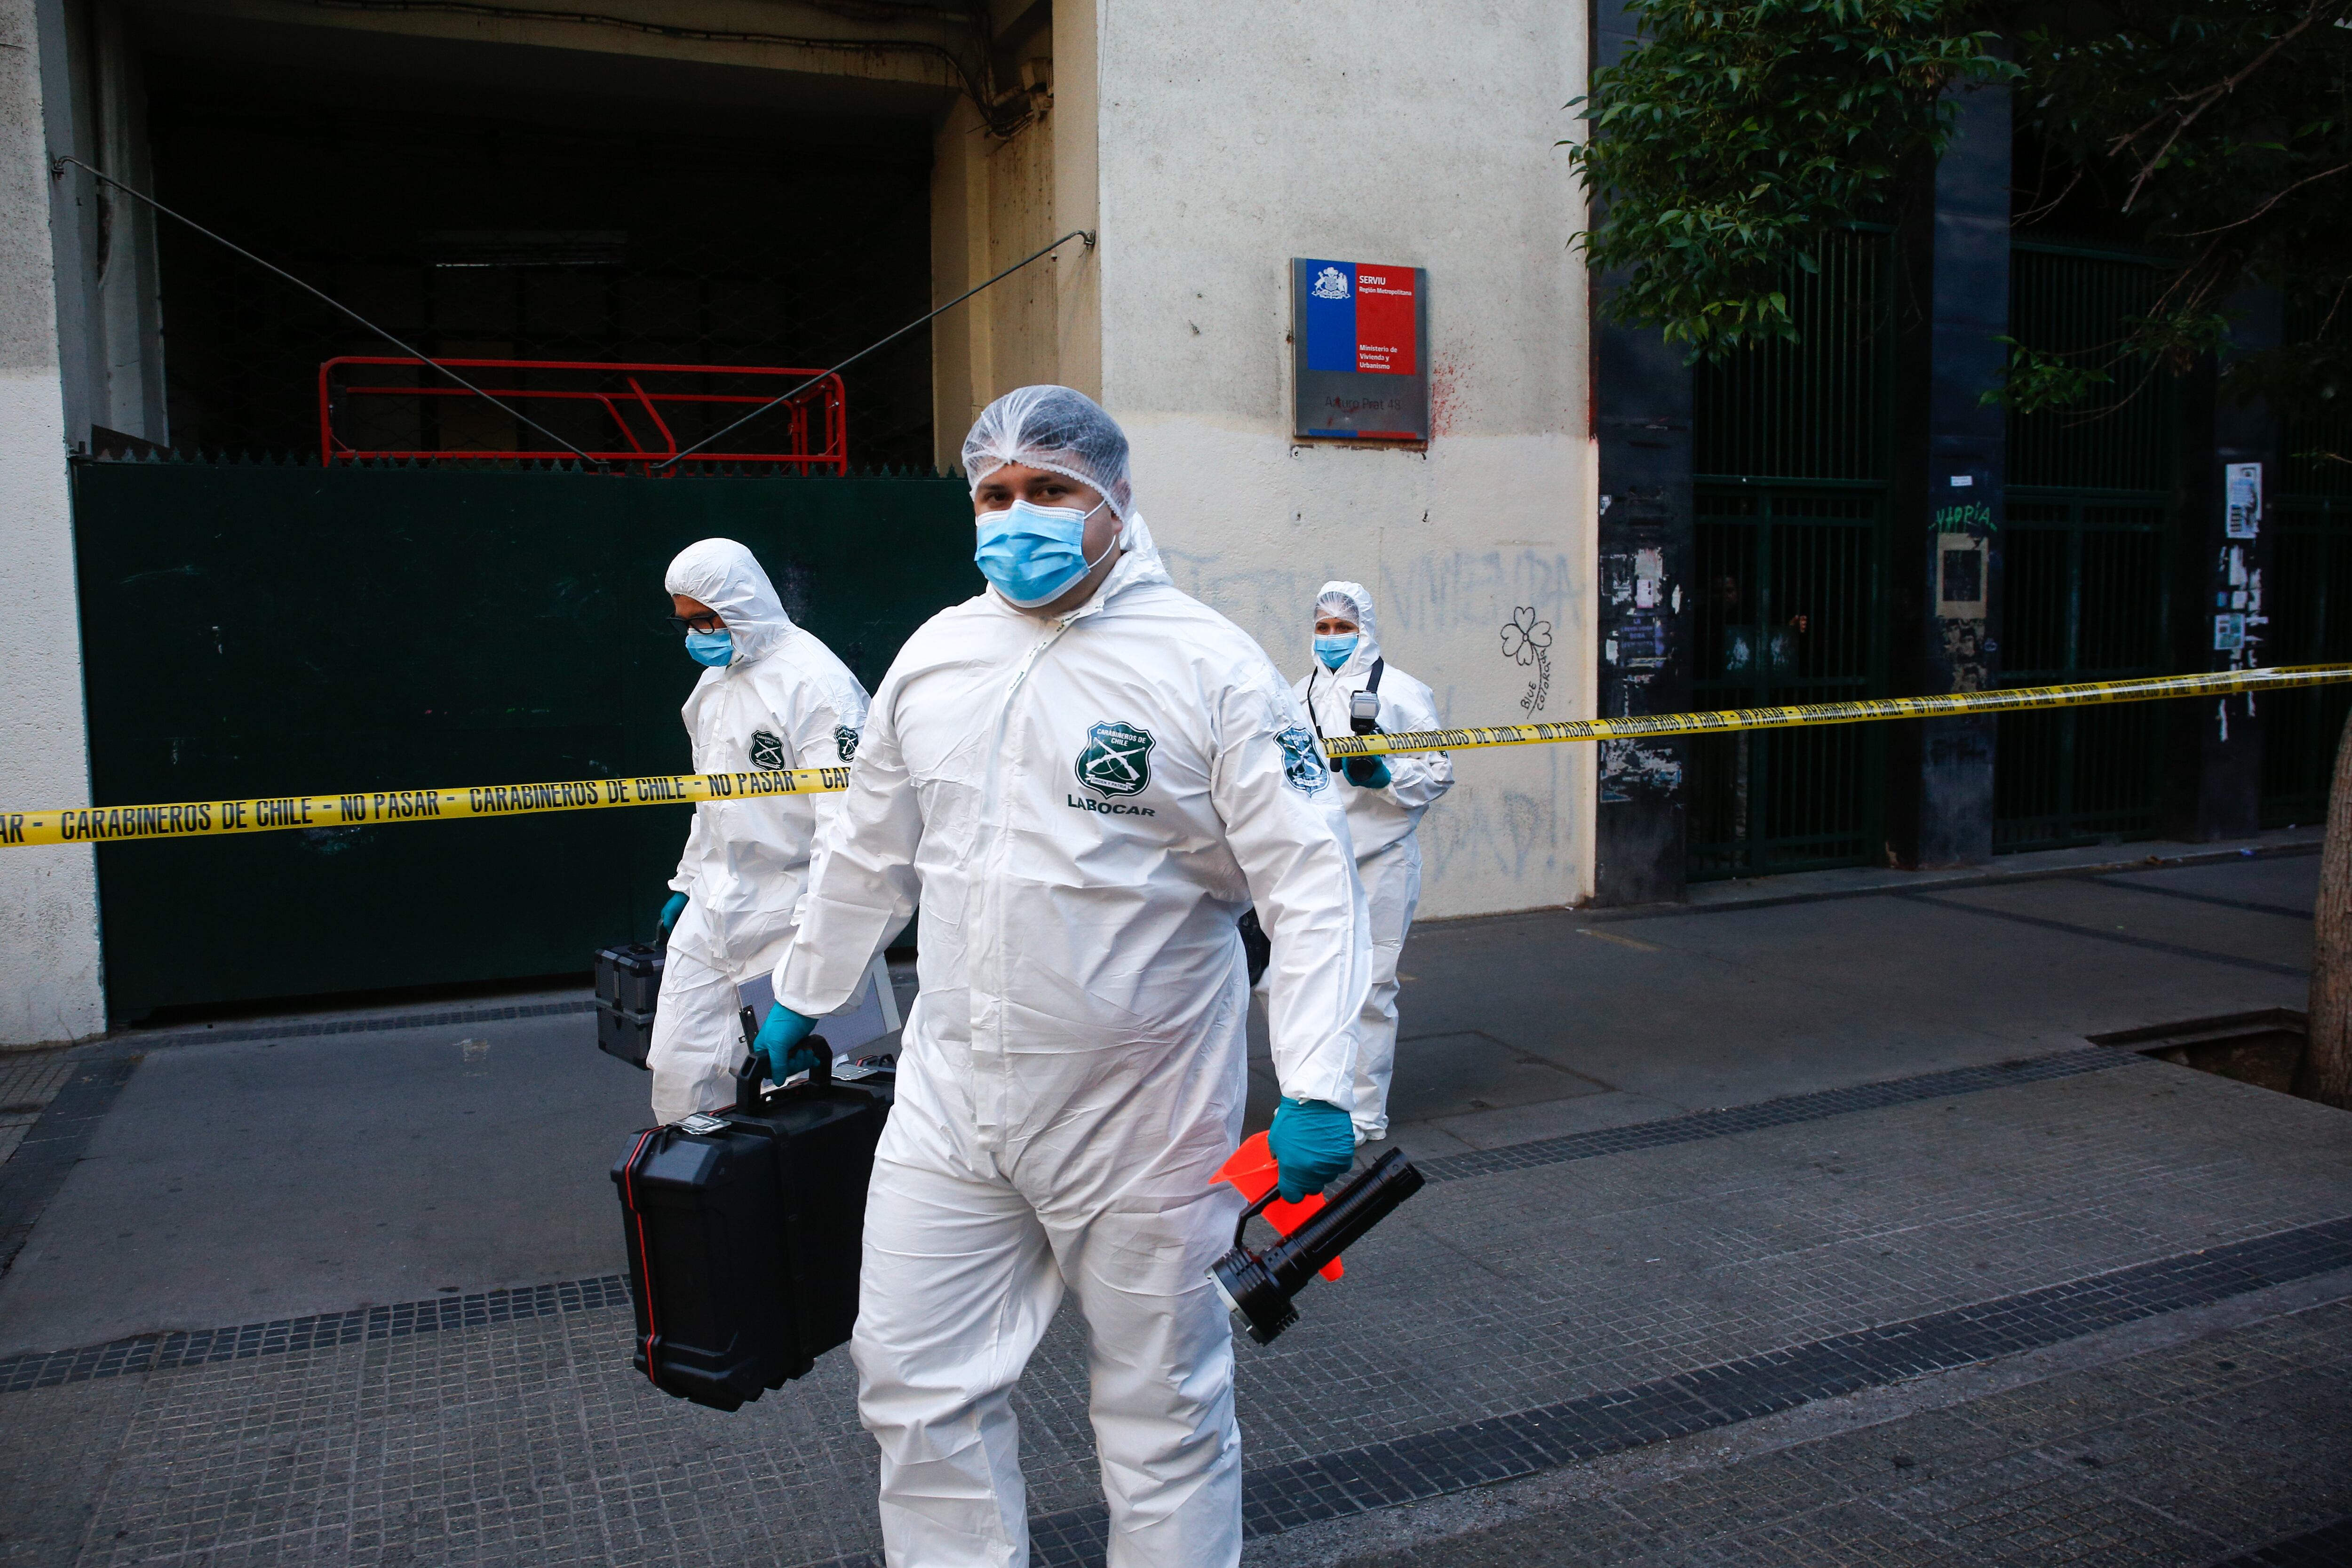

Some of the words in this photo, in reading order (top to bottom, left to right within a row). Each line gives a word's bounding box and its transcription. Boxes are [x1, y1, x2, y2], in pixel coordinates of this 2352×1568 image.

[1359, 275, 1386, 285] SERVIU
[1362, 398, 1384, 410] Prat
[1388, 398, 1400, 410] 48
[1319, 735, 1368, 755] PASAR
[1382, 729, 1470, 750] CARABINEROS
[1469, 728, 1490, 744] DE
[1488, 725, 1526, 742] CHILE
[1532, 724, 1554, 740] NO
[1550, 721, 1595, 739] PASAR
[1604, 714, 1681, 735] CARABINEROS
[1678, 713, 1698, 730] DE
[1692, 711, 1728, 728] CHILE
[1734, 709, 1753, 726] NO
[1749, 707, 1788, 725] PASAR
[1796, 702, 1862, 722] CARABINEROS
[1859, 700, 1877, 717] DE
[1875, 699, 1904, 716] CHILE
[1097, 728, 1137, 742] CARABINEROS
[1111, 738, 1128, 747] CHILE
[61, 804, 211, 840] CARABINEROS
[222, 802, 247, 829] DE
[256, 798, 313, 827] CHILE
[341, 795, 366, 822] NO
[374, 791, 440, 820] PASAR
[470, 781, 598, 813] CARABINEROS
[606, 780, 630, 804] DE
[635, 776, 687, 801] CHILE
[707, 774, 732, 797] NO
[735, 770, 796, 795] PASAR
[1068, 794, 1155, 816] LABOCAR
